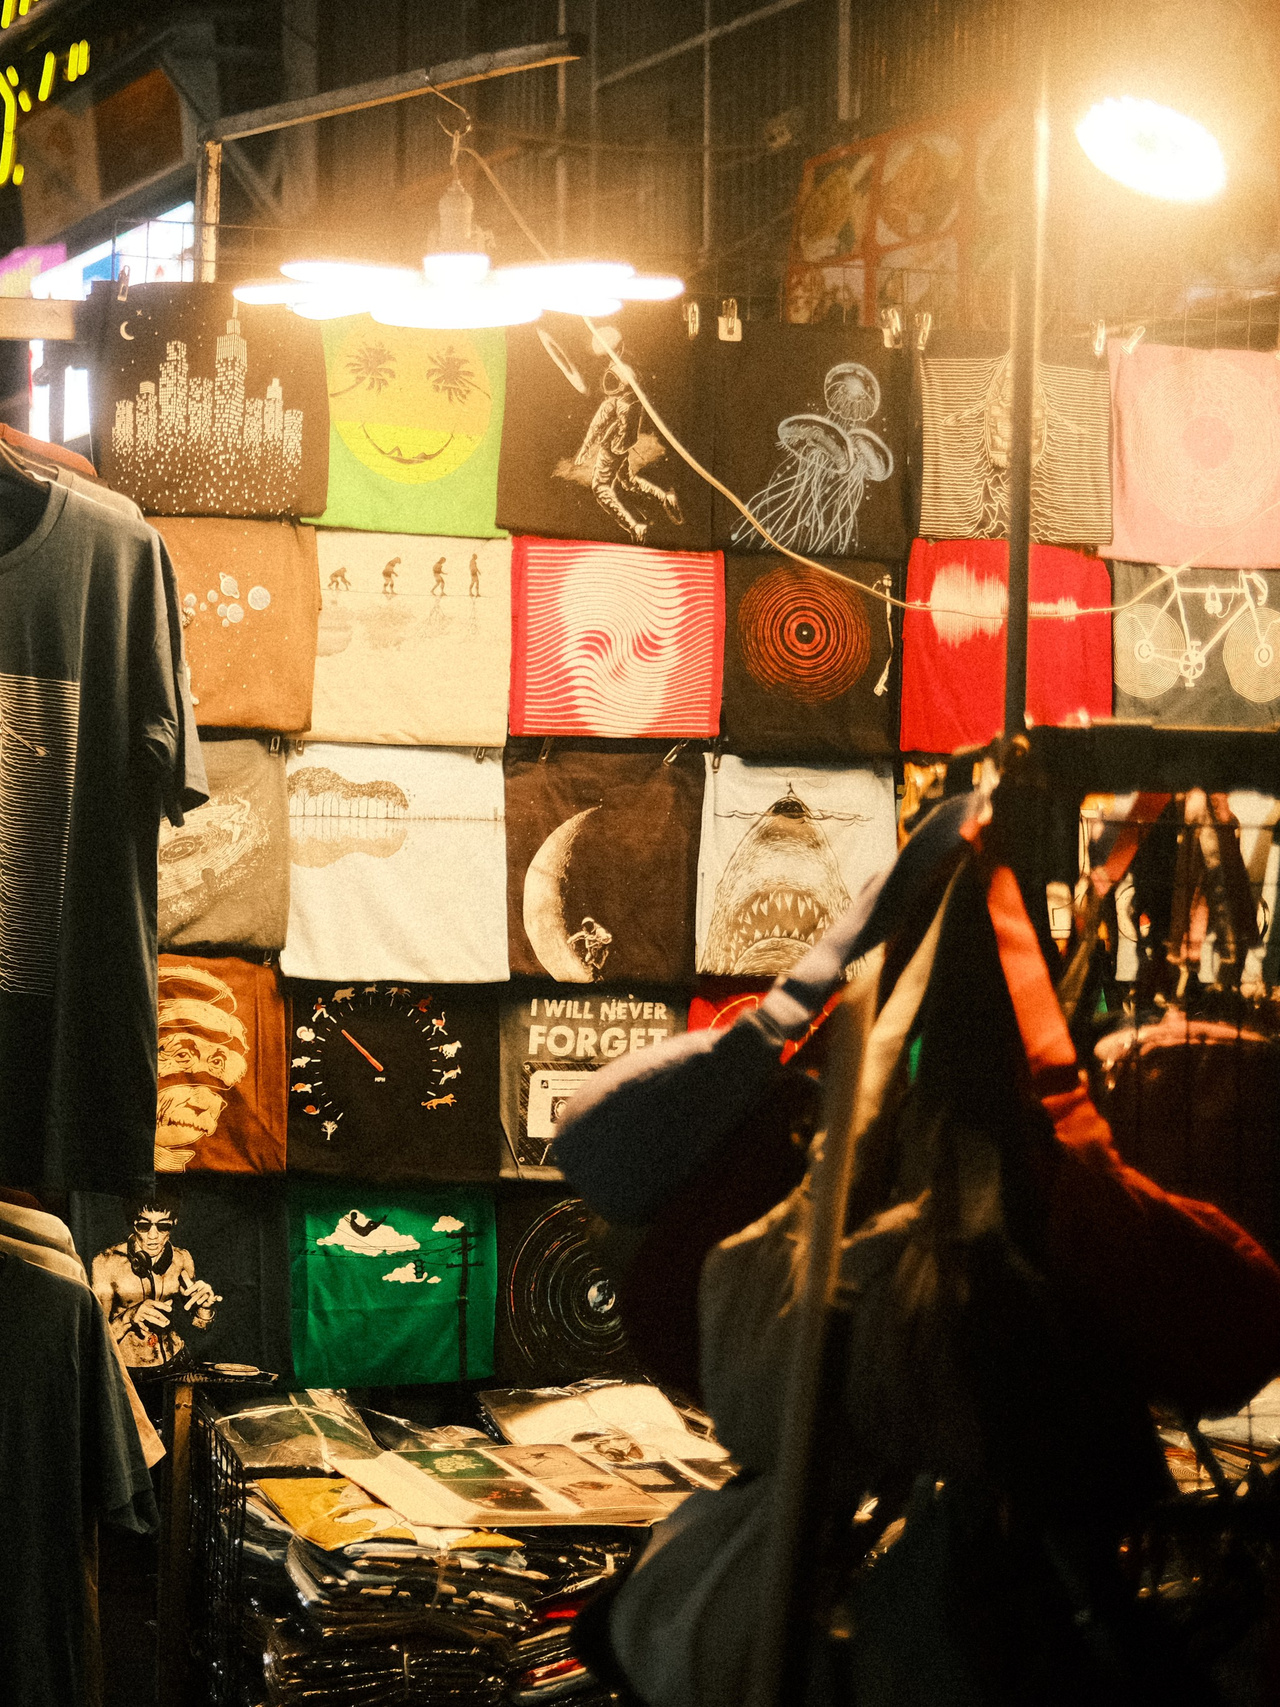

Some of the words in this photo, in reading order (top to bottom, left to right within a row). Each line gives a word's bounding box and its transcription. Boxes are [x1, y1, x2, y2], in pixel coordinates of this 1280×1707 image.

[530, 998, 538, 1017] I
[543, 998, 594, 1020] WILL
[600, 1000, 668, 1021] NEVER
[528, 1025, 669, 1058] FORGET
